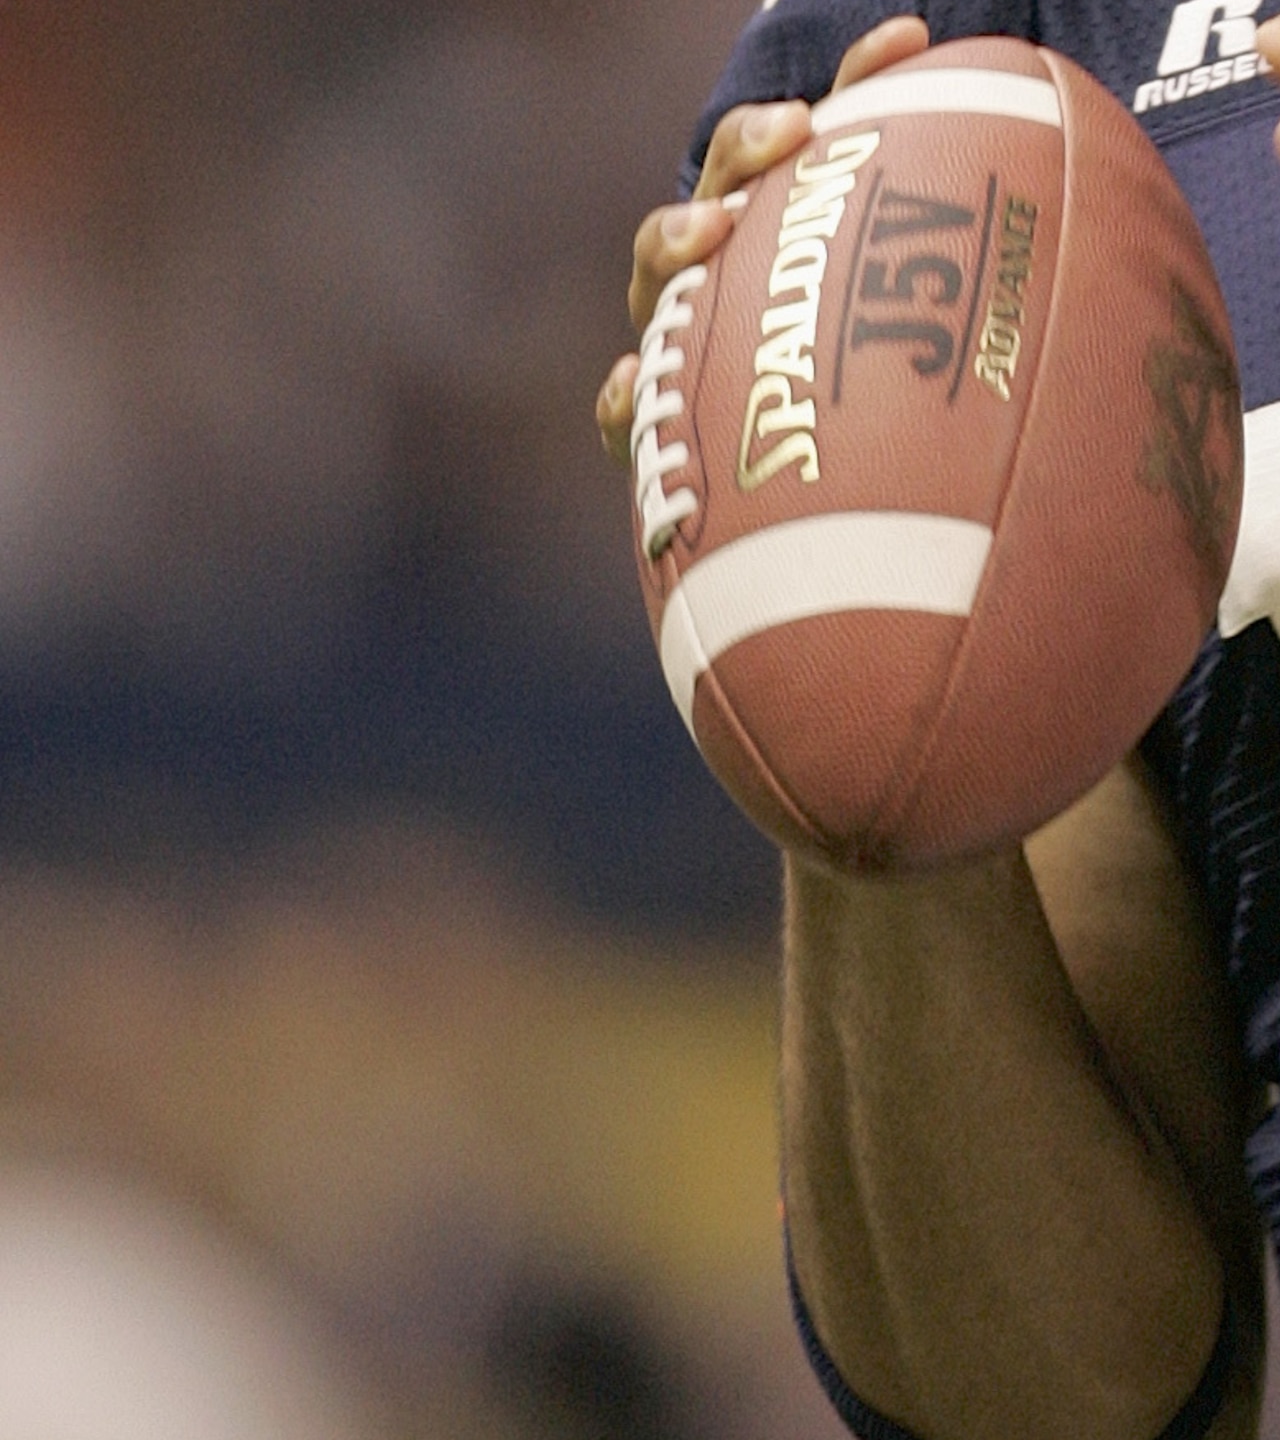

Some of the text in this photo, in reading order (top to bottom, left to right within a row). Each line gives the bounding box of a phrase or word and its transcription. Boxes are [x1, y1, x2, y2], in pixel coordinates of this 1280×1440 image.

[1133, 51, 1275, 113] RUSSEL
[735, 130, 882, 493] SPALDING
[974, 193, 1040, 403] ADVANCE
